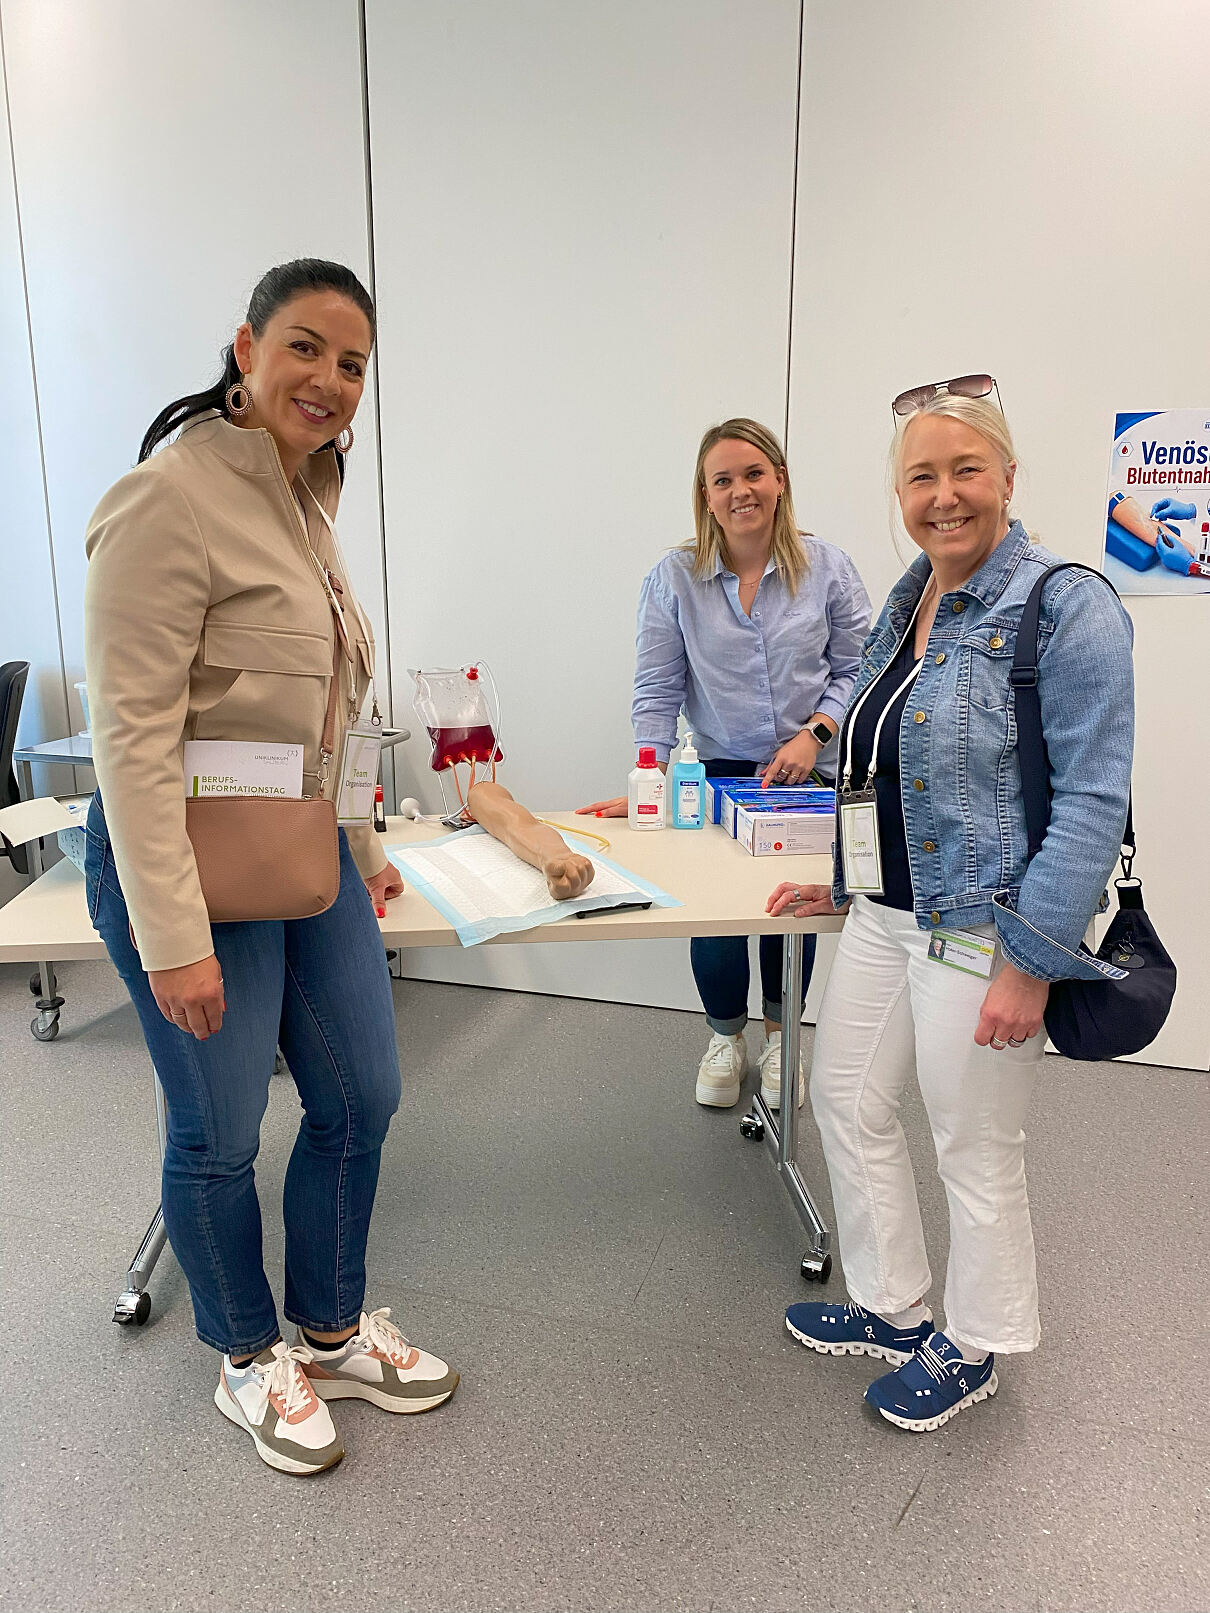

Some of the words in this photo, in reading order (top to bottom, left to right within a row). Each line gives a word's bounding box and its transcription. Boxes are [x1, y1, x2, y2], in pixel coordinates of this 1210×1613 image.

[1142, 440, 1210, 465] Venös
[353, 768, 368, 778] Team
[201, 775, 238, 783] BERUFS-
[345, 779, 373, 788] Organisation
[201, 784, 286, 794] INFORMATIONSTAG
[852, 840, 867, 848] Team
[849, 851, 874, 859] Organisation
